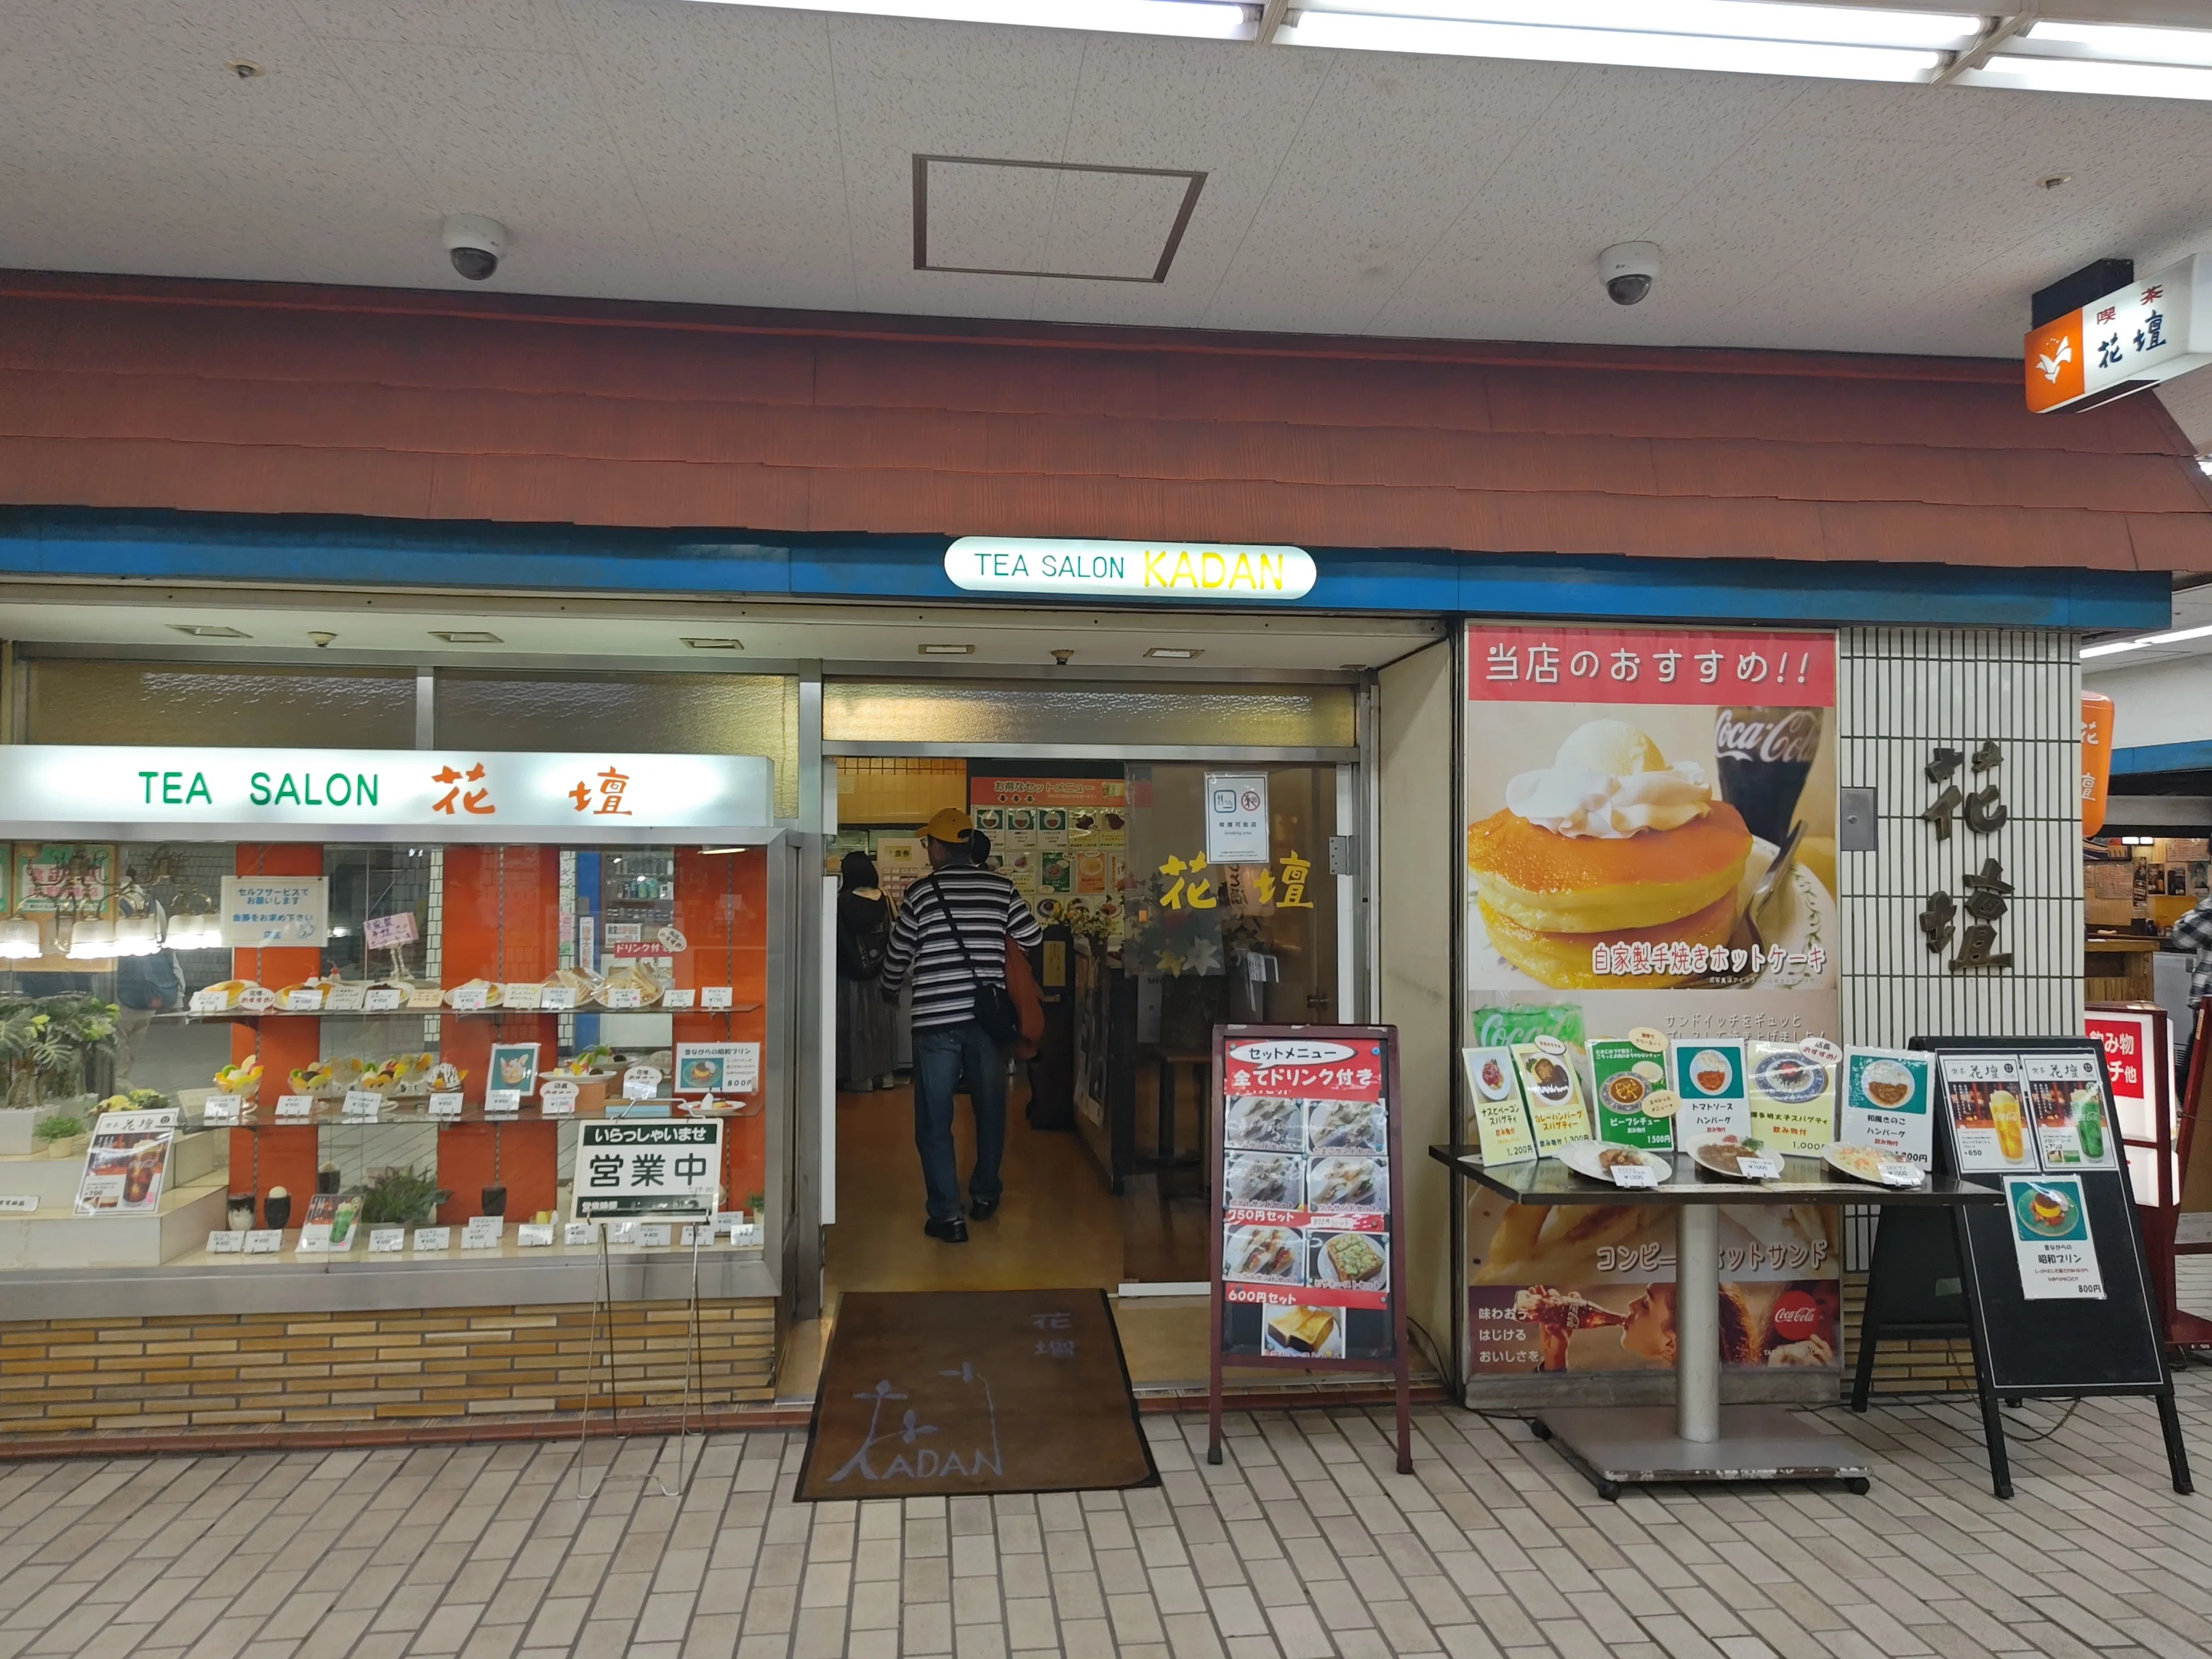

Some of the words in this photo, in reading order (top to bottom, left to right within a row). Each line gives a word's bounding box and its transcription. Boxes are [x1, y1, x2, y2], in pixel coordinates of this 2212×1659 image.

[2097, 309, 2166, 368] 花壇
[974, 553, 1029, 577] TEA
[1042, 555, 1124, 579] SALON
[1144, 550, 1284, 590] KADAN
[1486, 642, 1808, 683] 当店のおすすめ!!
[138, 772, 212, 804] TEA
[250, 772, 379, 806] SALON
[431, 761, 633, 816] 花壇
[1918, 741, 2016, 971] 花壇
[1158, 850, 1314, 910] 花壇
[1592, 941, 1827, 976] 自家製手焼きホットケーキ
[1248, 1047, 1337, 1060] セットメニュー
[1232, 1068, 1374, 1087] 全てドリンク付き
[2107, 1060, 2137, 1084] チ他
[1610, 1117, 1661, 1126] ビーフシチュー
[1867, 1114, 1907, 1125] 和風きのこ
[594, 1127, 707, 1143] いらっしゃいませ
[1867, 1128, 1906, 1138] ハンバーグ
[1506, 1145, 1534, 1157] 1,200円
[589, 1152, 707, 1187] 営業中
[1228, 1209, 1294, 1223] 750円セット
[1229, 1290, 1297, 1305] 600円セット
[2078, 1284, 2102, 1293] 800円
[1479, 1328, 1526, 1342] はじける
